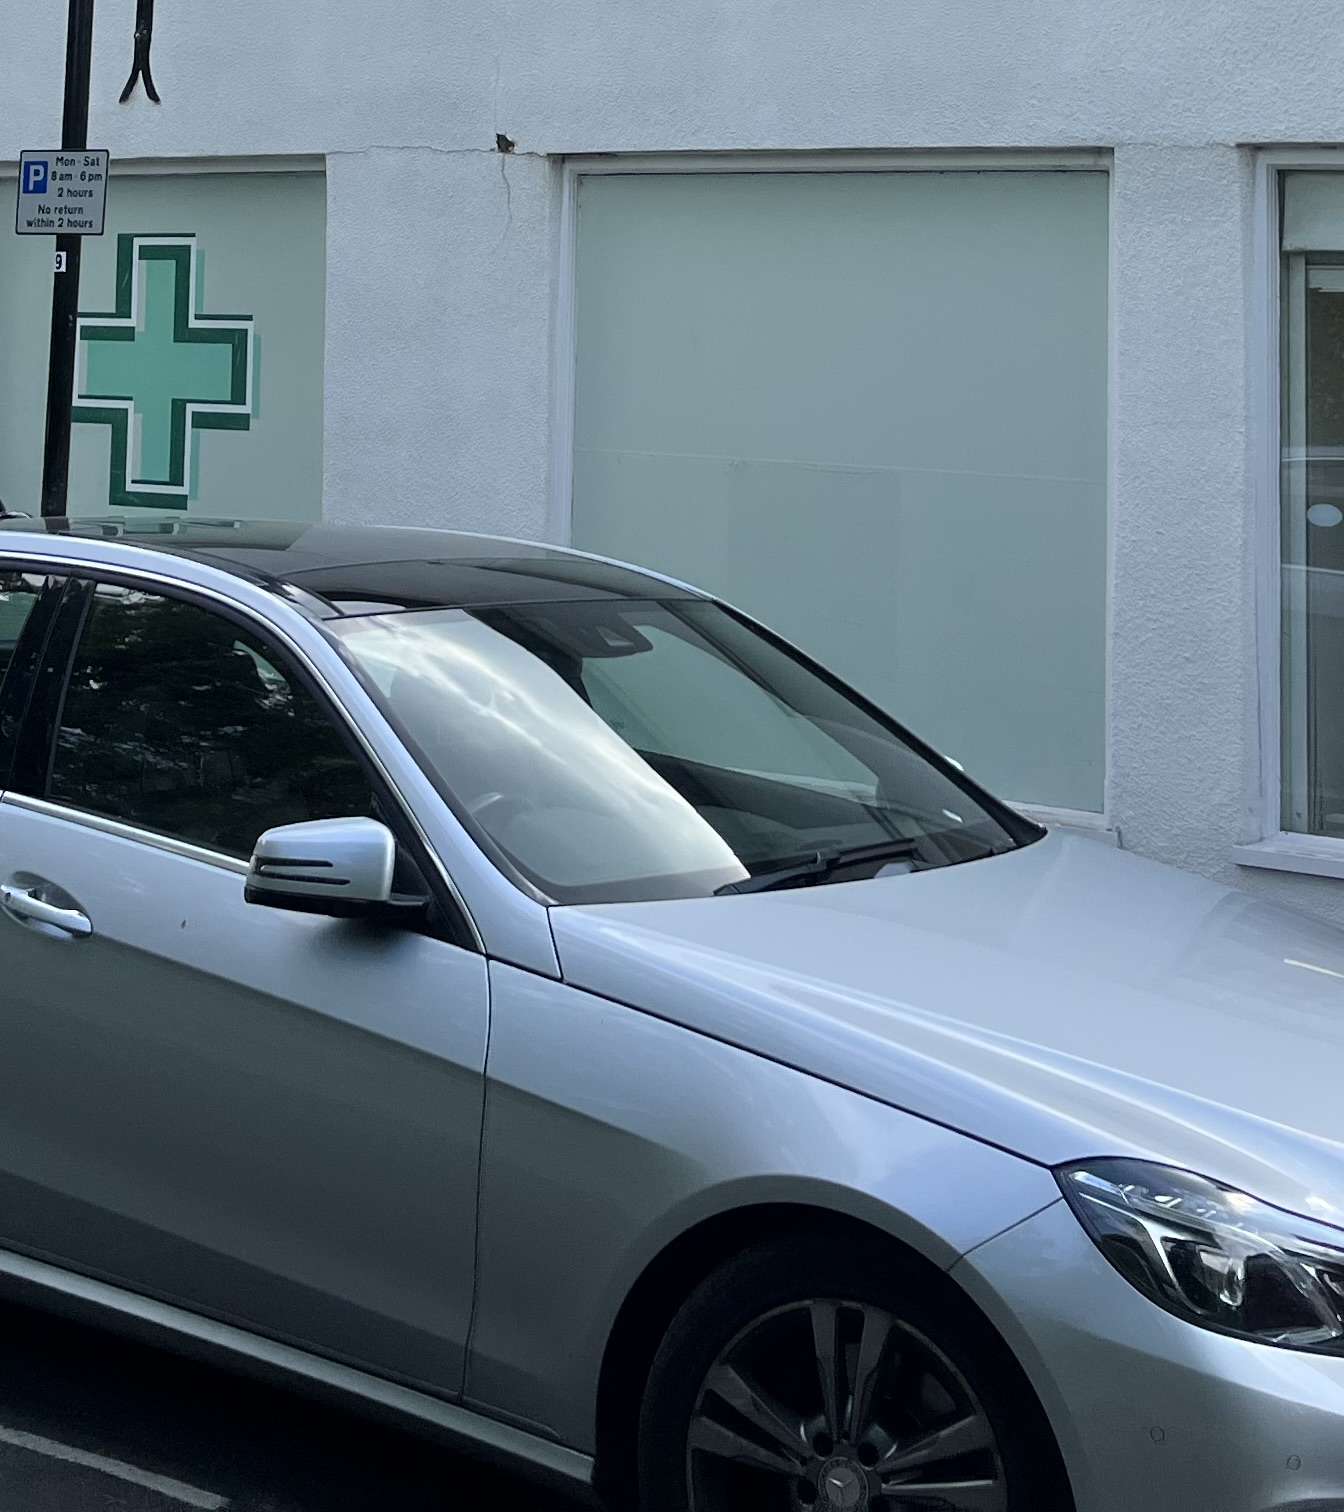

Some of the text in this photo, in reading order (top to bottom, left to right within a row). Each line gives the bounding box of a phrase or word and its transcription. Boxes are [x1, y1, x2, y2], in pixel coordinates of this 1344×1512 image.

[55, 156, 76, 167] Mon
[83, 156, 100, 167] Sat
[28, 164, 45, 192] P
[57, 187, 93, 198] 2 hours
[37, 204, 83, 215] No return
[26, 218, 93, 229] within 2 hours
